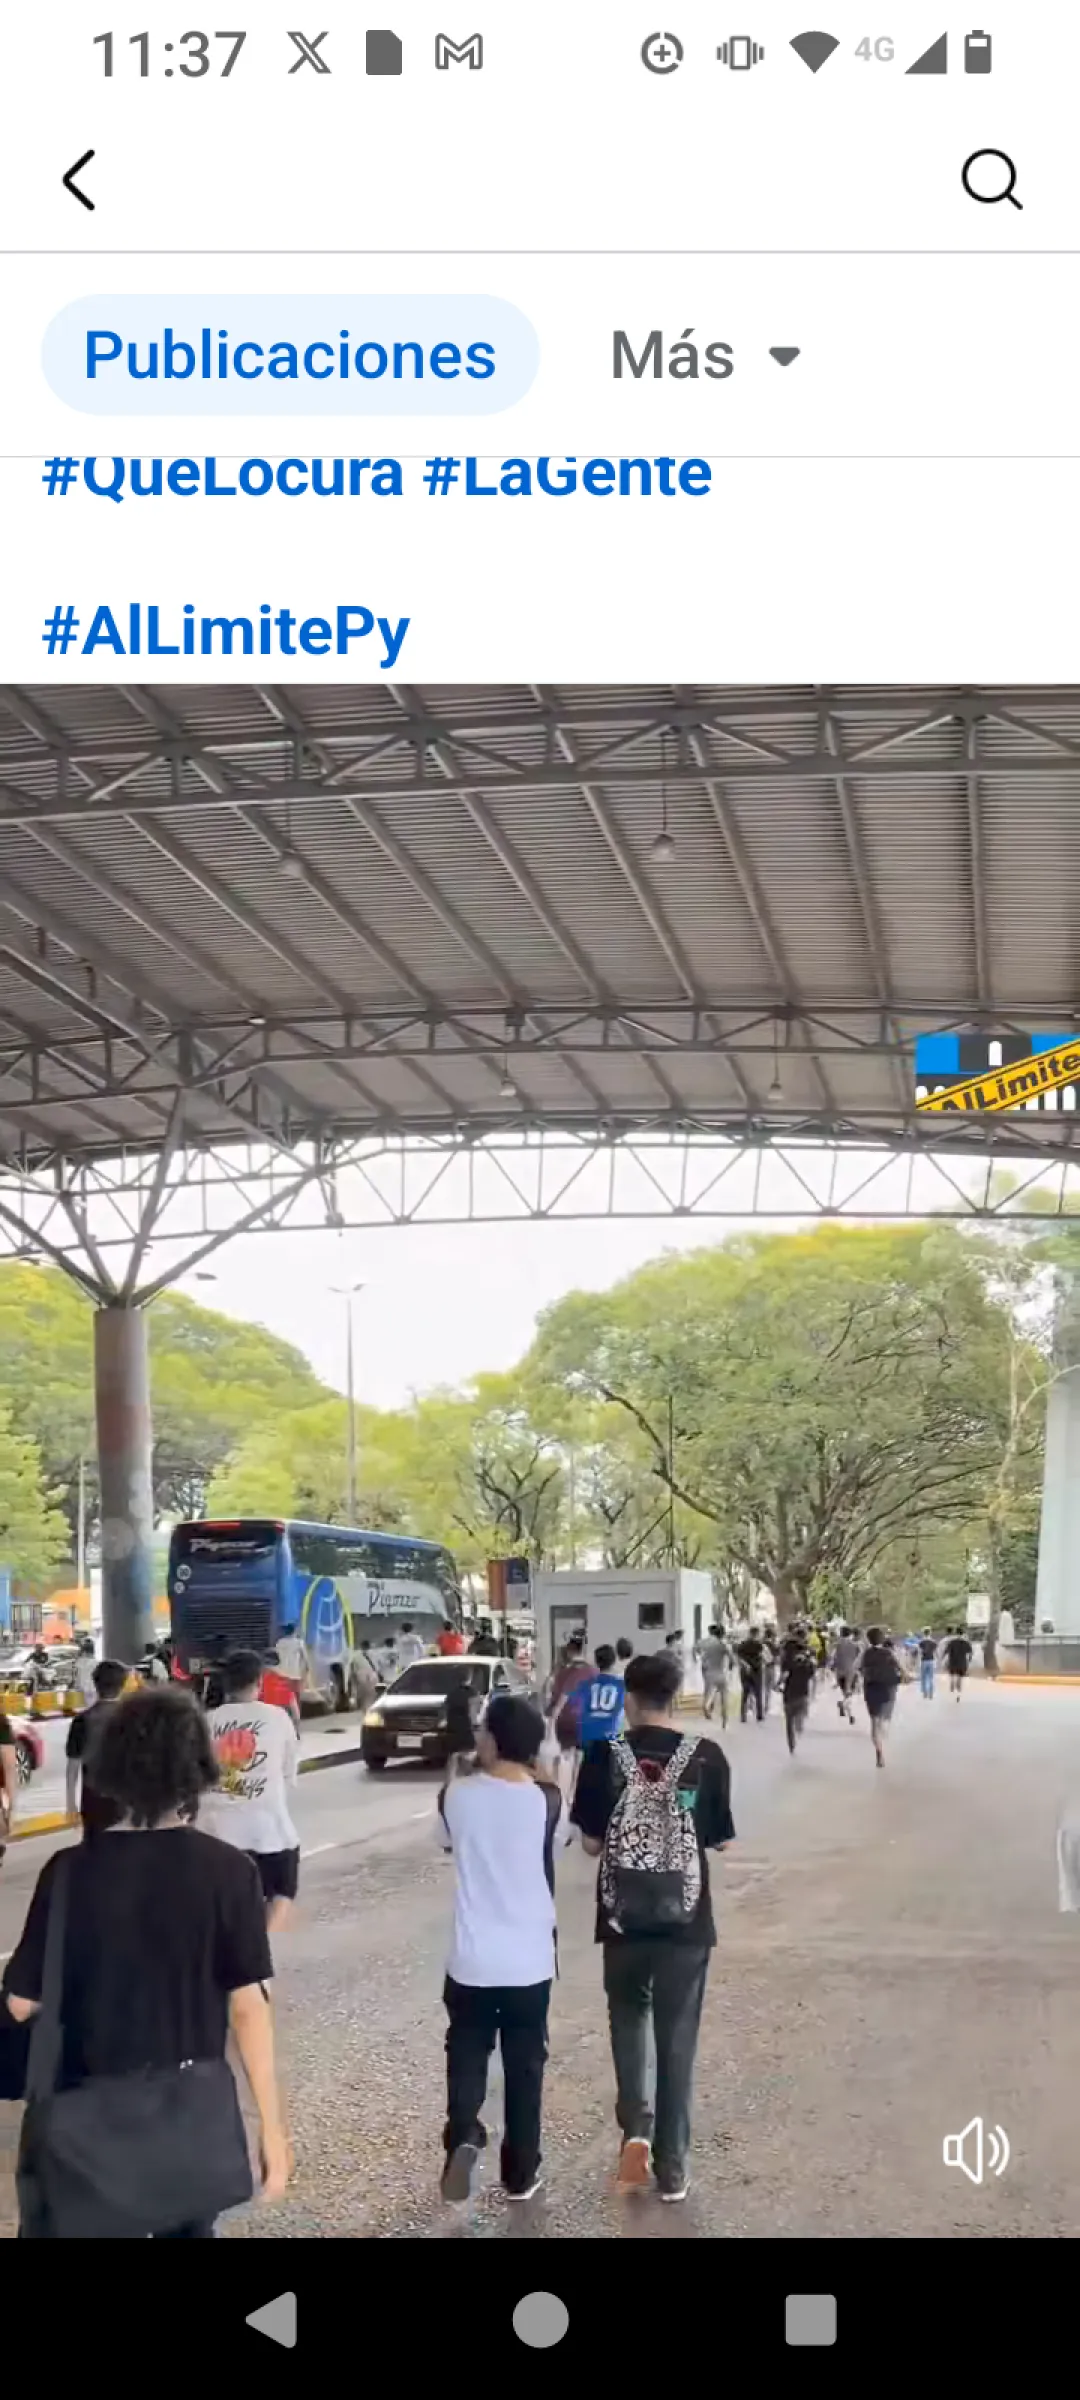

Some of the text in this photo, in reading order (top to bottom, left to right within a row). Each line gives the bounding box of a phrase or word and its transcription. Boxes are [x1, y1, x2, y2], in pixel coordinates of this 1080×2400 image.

[93, 30, 246, 78] 11:37
[853, 36, 895, 62] 4G
[86, 327, 496, 380] Publicaciones
[612, 327, 735, 380] Más
[42, 457, 712, 504] #QueLocura #LaGente
[42, 603, 411, 669] #AlLimitePy
[590, 1682, 618, 1711] 10
